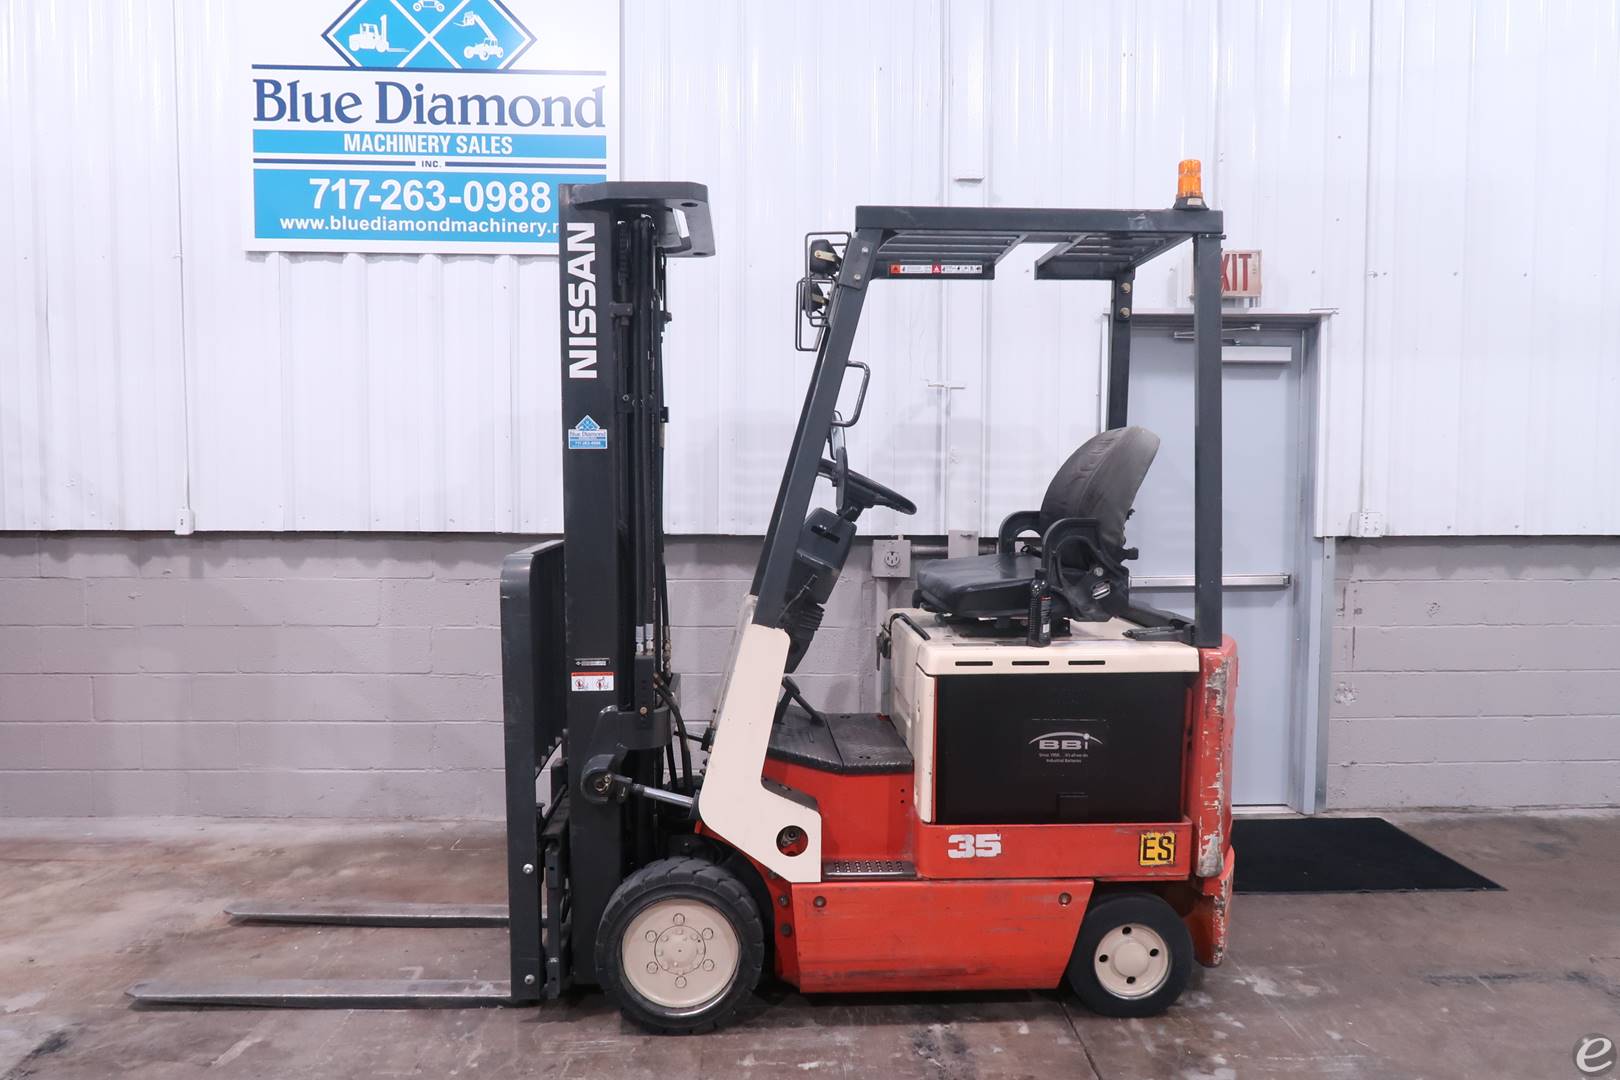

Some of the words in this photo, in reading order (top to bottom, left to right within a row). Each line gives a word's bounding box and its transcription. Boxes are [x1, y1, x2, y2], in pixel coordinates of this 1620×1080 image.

[252, 78, 363, 124] Blue
[374, 80, 607, 128] Diamond
[343, 133, 451, 154] MACHINERY
[456, 135, 514, 155] SALES
[421, 160, 442, 168] INC.
[309, 177, 552, 214] 717-263-0988
[1220, 253, 1252, 292] XIT
[567, 222, 598, 379] NISSAN
[947, 833, 1002, 859] 35
[1142, 835, 1172, 861] ES
